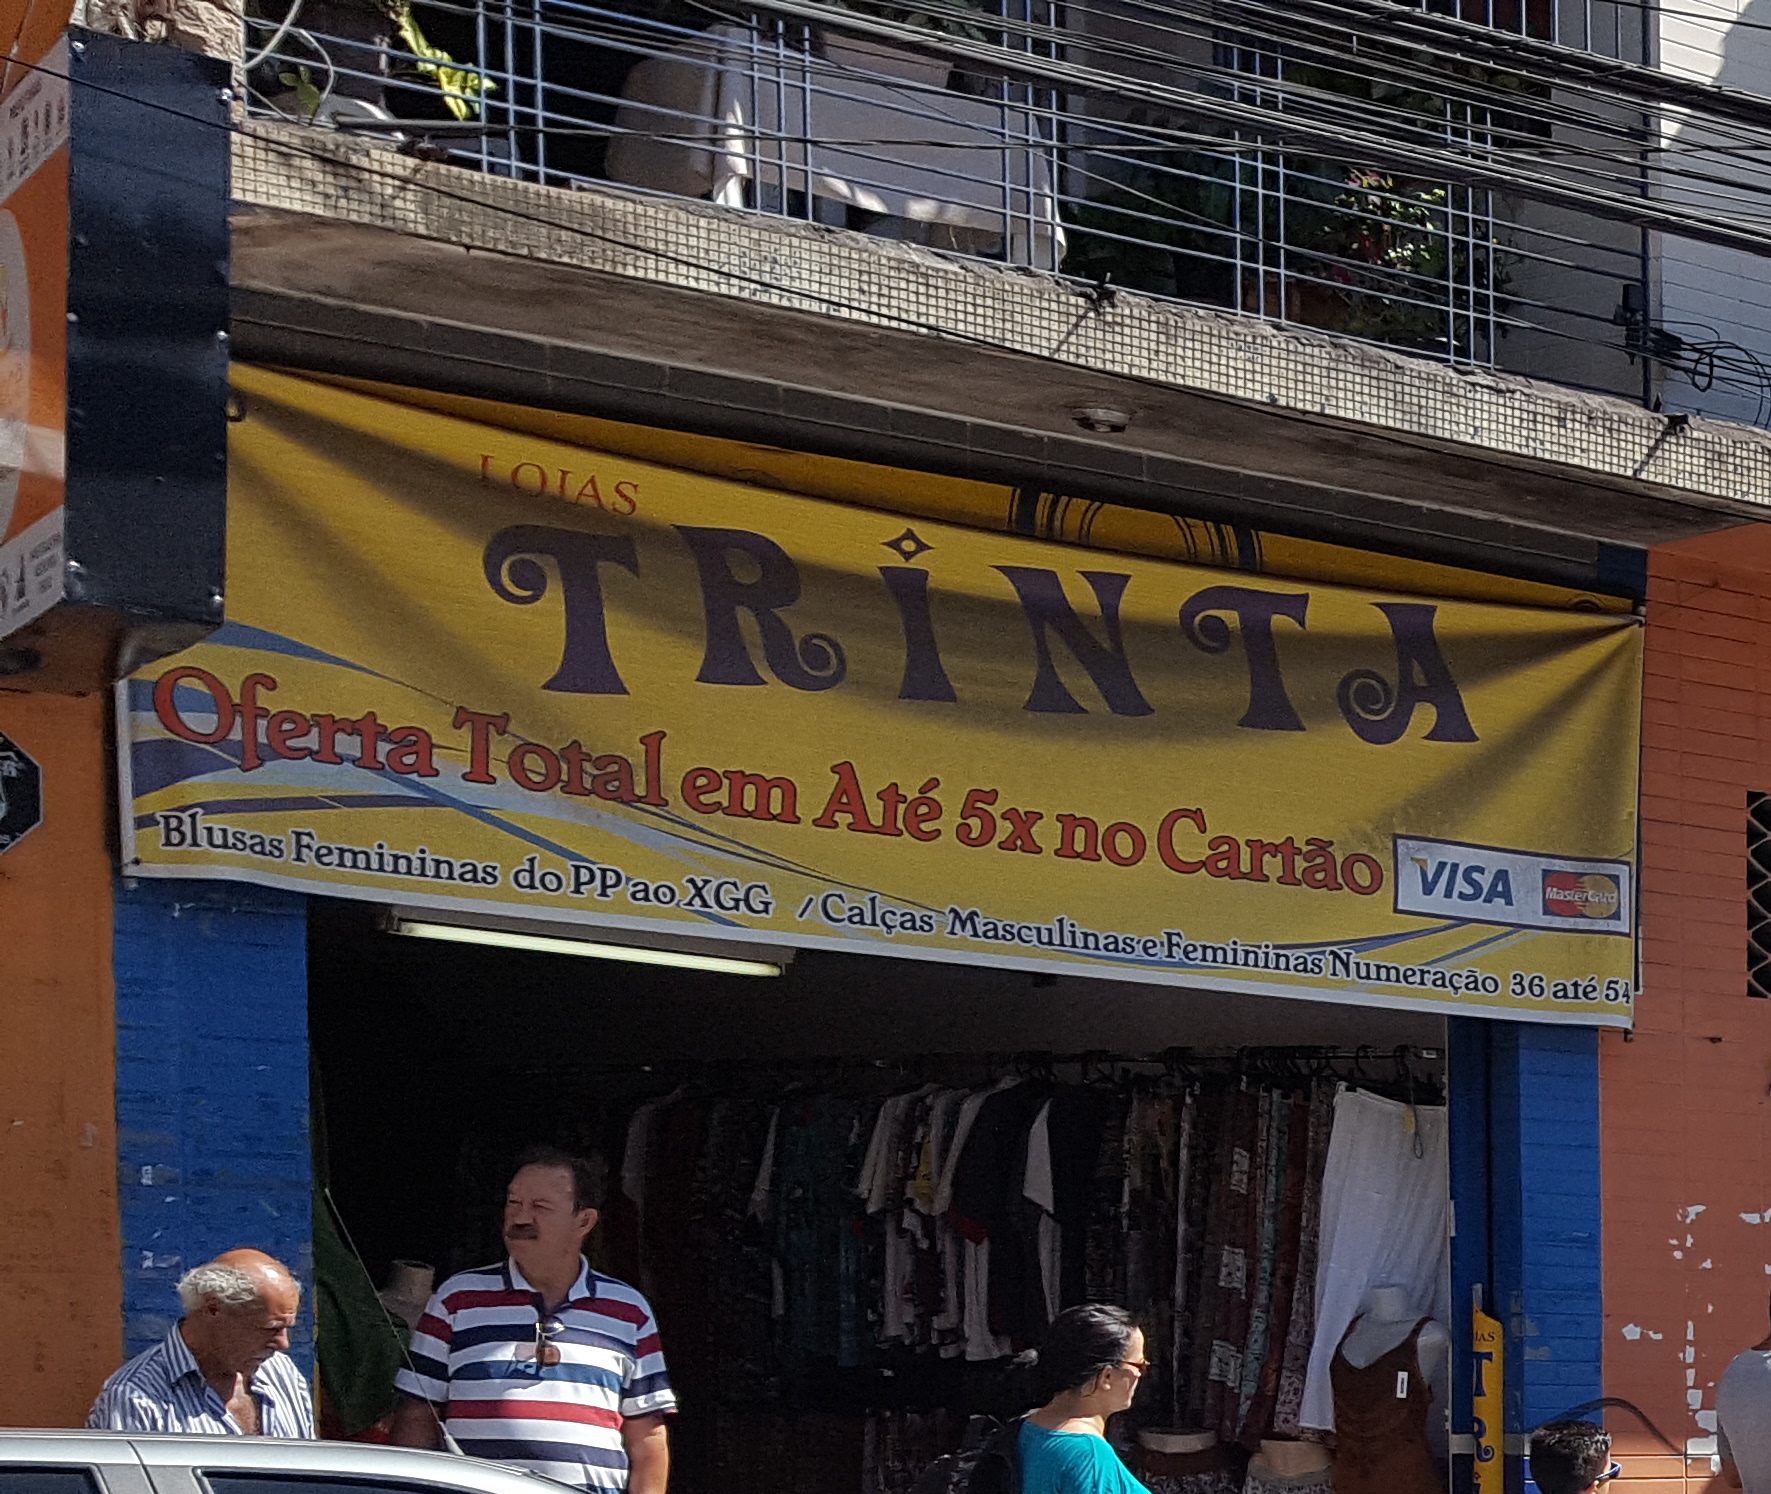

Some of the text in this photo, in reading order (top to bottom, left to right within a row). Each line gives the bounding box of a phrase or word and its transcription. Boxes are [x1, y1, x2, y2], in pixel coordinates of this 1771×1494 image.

[153, 664, 1385, 896] Oferta Total em Até 5x no Cartão
[157, 811, 286, 860] Blusas
[288, 827, 499, 887] Femininas
[513, 853, 563, 895] do
[568, 861, 624, 900] PP
[628, 878, 678, 907] ao
[681, 875, 774, 917] XGG
[945, 906, 1137, 959] Masculinas
[1163, 930, 1324, 979] Femininas
[1329, 950, 1501, 997] Numeração
[1509, 971, 1546, 998] 36
[1551, 974, 1600, 1003] até
[1411, 855, 1515, 907] VISA
